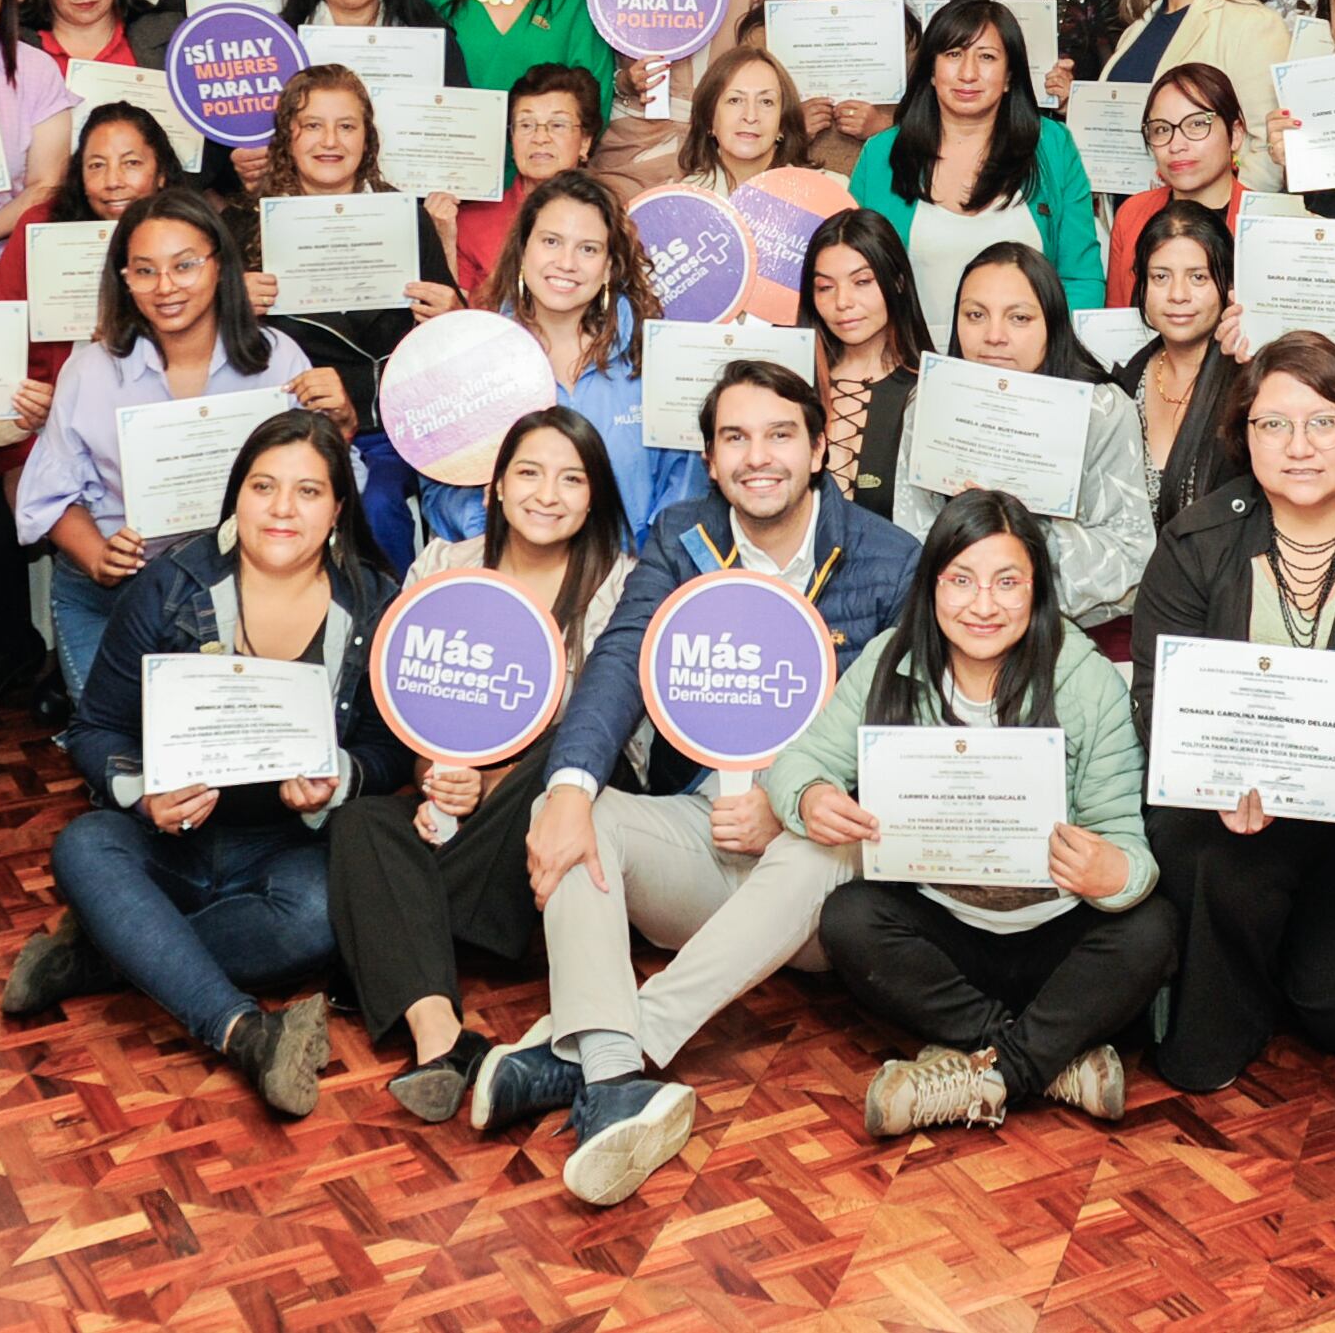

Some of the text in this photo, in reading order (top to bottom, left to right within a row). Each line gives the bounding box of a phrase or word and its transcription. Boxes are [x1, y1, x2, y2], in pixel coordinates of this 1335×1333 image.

[616, 11, 704, 28] POLÍTICA!
[183, 37, 273, 65] ¡SÍ HAY
[195, 57, 280, 80] MUJERES
[198, 76, 283, 100] PARA LA
[203, 94, 280, 117] POLÍTIC
[645, 236, 689, 282] ás
[660, 266, 709, 307] mocracia
[403, 625, 494, 671] Más
[671, 632, 762, 670] Más
[399, 658, 491, 690] Mujeres
[670, 667, 761, 693] Mujeres
[396, 676, 489, 706] Democracia
[669, 686, 762, 707] Democracia
[1179, 706, 1214, 717] ROSAURA
[1217, 710, 1255, 719] CAROLINA
